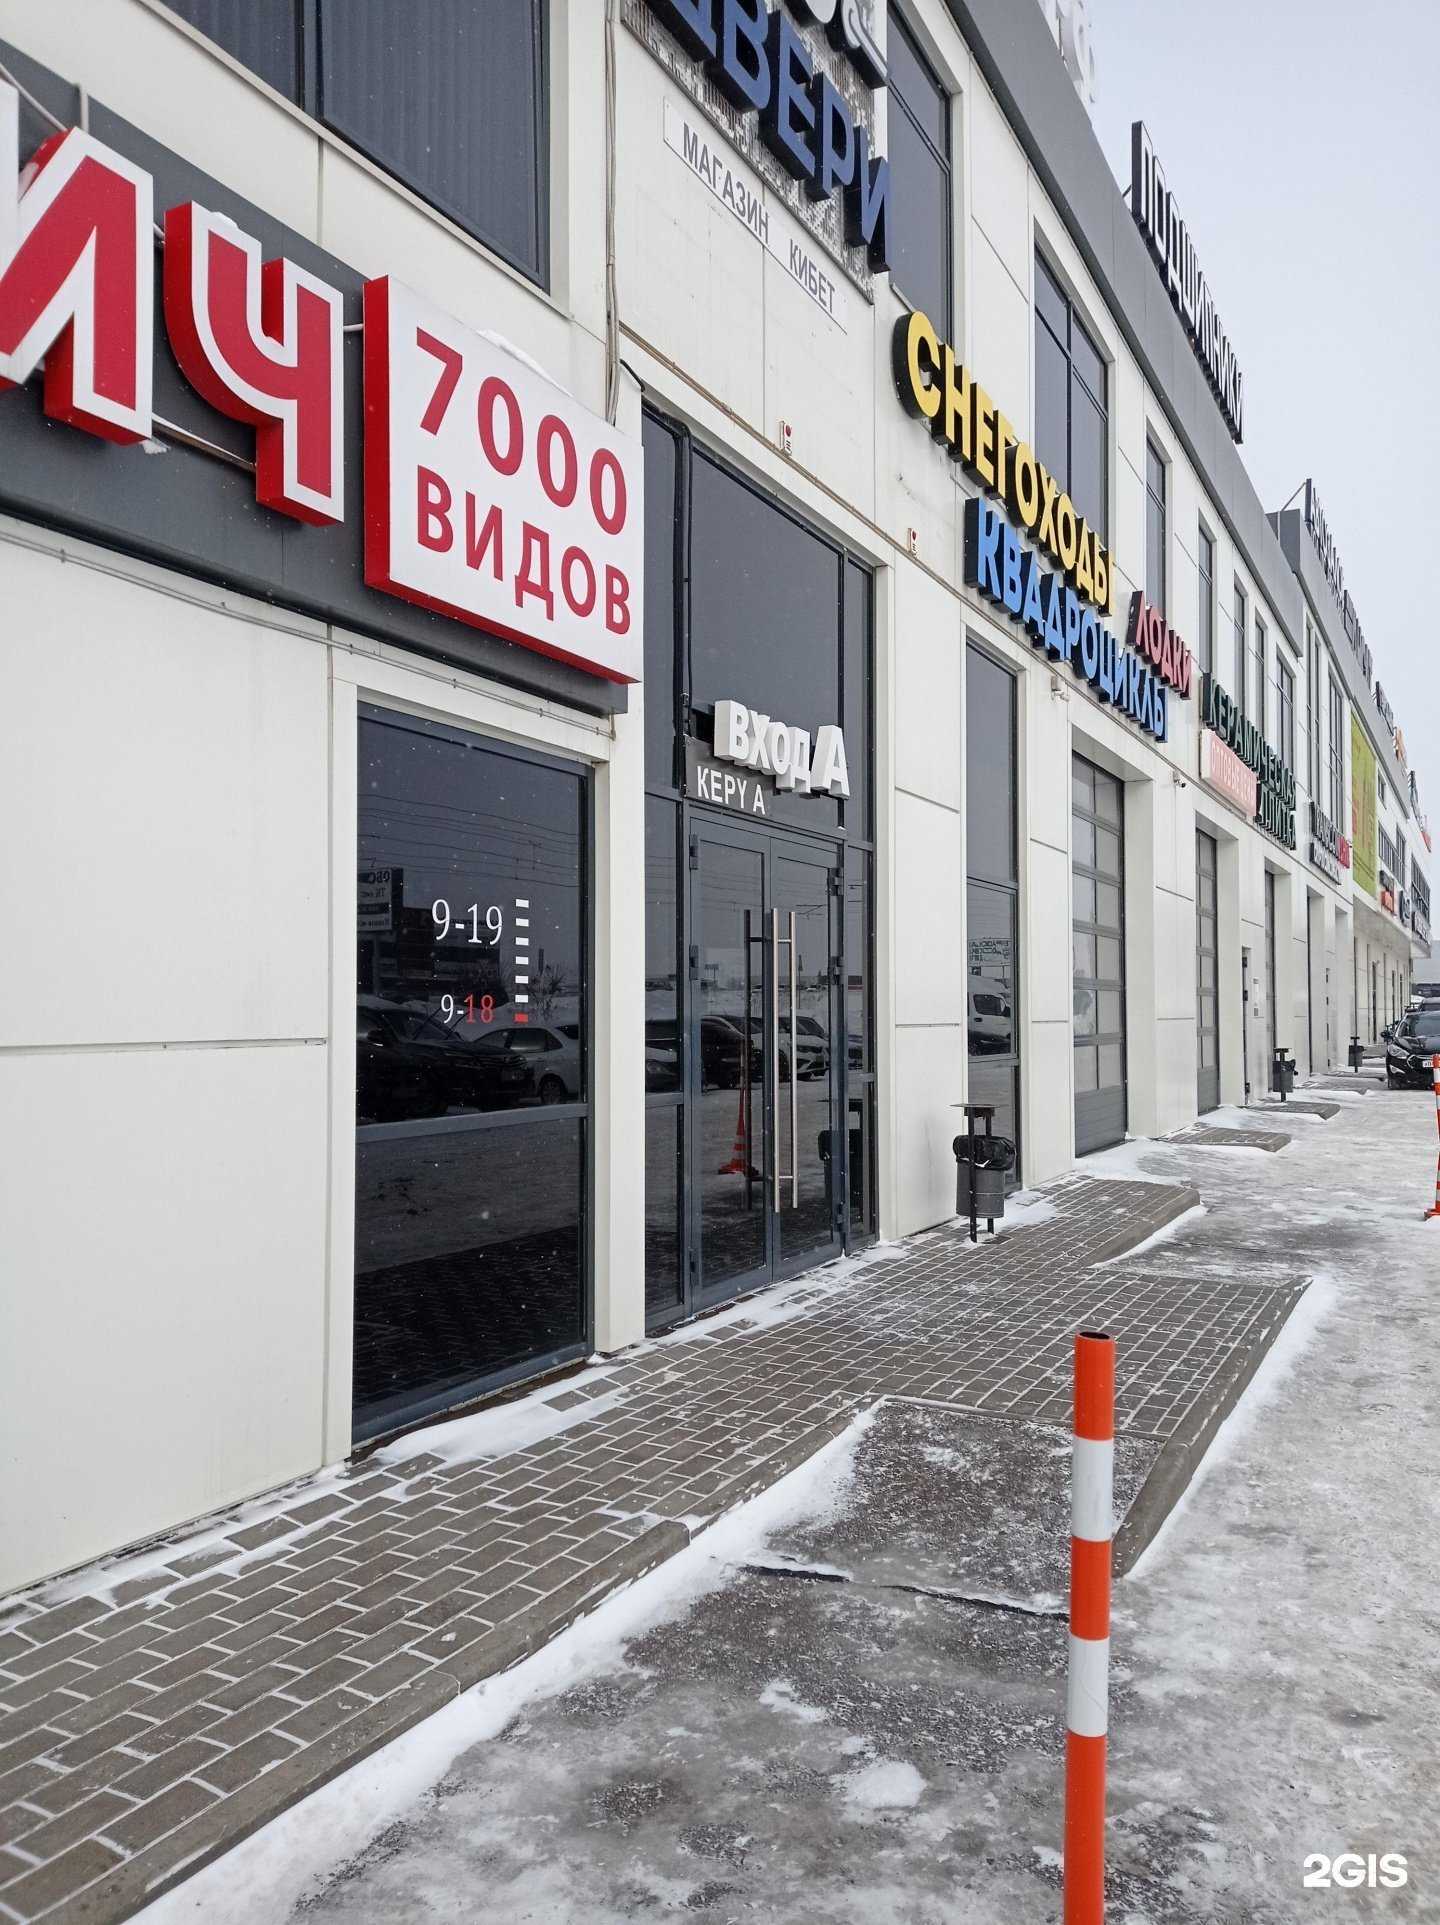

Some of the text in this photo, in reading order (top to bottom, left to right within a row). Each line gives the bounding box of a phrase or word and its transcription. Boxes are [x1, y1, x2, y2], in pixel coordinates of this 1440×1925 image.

[682, 122, 836, 316] МАГАЗИН КИБЕТ
[1132, 120, 1244, 444] ПОДШИПНИКИ
[414, 326, 627, 536] 7000
[900, 310, 1113, 615] СНЕГОХОДЫ
[416, 464, 631, 636] ВИДОВ
[966, 496, 1168, 744] КВАДРОЦИКЛЫ
[1128, 590, 1192, 700] ЛОДКИ
[714, 699, 812, 797] ВХОД
[1203, 672, 1297, 812] КЕРАМИЧЕСКАЯ
[1259, 780, 1297, 850] ПЛИТКА
[431, 899, 503, 946] 9-19
[440, 994, 496, 1024] 9-18
